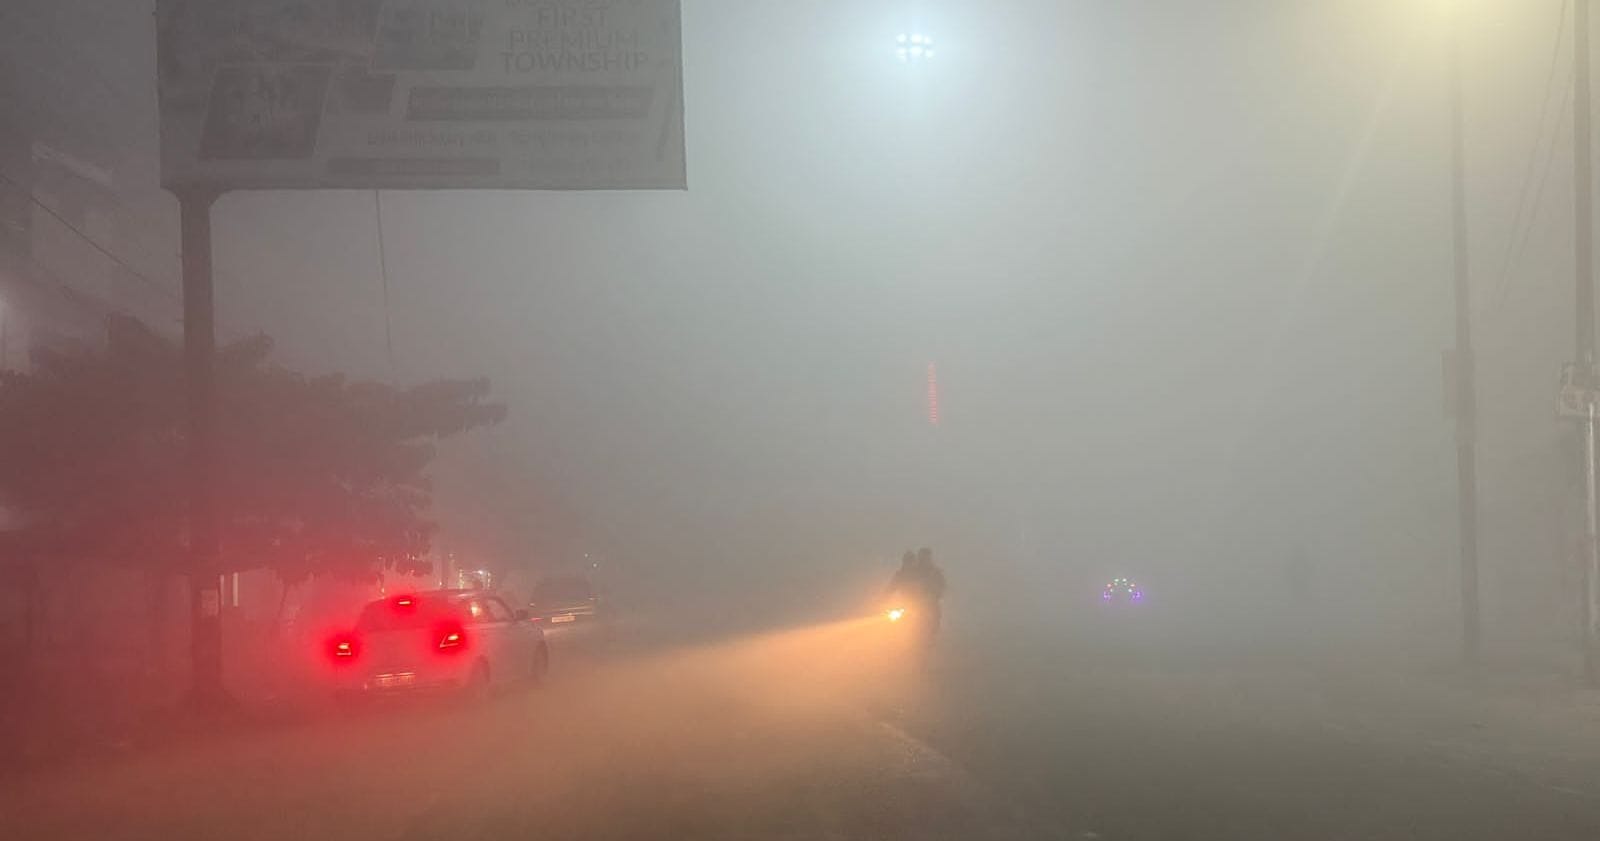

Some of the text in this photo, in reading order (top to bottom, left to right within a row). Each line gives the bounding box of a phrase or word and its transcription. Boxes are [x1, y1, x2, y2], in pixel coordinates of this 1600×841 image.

[536, 6, 609, 28] FIRST
[508, 29, 640, 51] PREMIUM
[499, 51, 649, 73] TOWNSHIP
